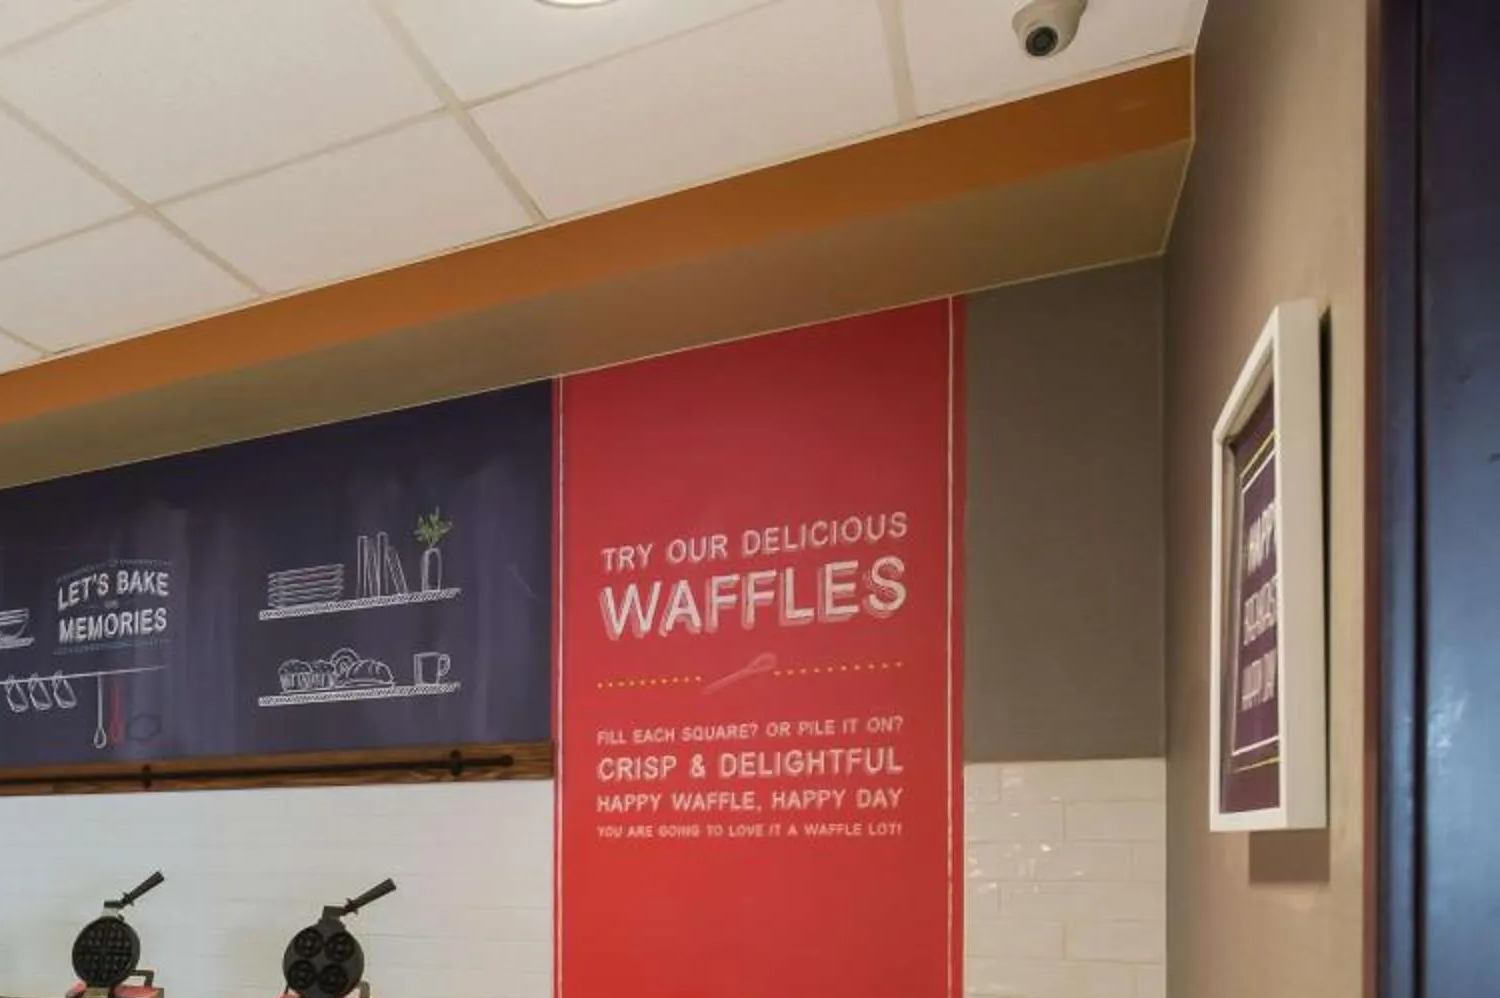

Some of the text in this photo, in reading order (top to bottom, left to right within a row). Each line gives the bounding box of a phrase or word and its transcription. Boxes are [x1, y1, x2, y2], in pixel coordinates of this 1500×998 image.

[602, 511, 907, 573] TRY OUR DELICIOUS
[57, 569, 169, 612] LET'S BAKE
[599, 555, 907, 641] WAFFLES
[58, 607, 167, 644] MEMORIES
[597, 714, 903, 745] FILL EACH SQUARE? OR PILE IT ON?
[597, 746, 904, 782] CRISP & DELIGHTFUL
[597, 787, 903, 813] HAPPY WAFFLE, HAPPY DAY
[597, 822, 903, 838] YOU ARE GOING TO LOVE IT A WAFFLE LOT!
